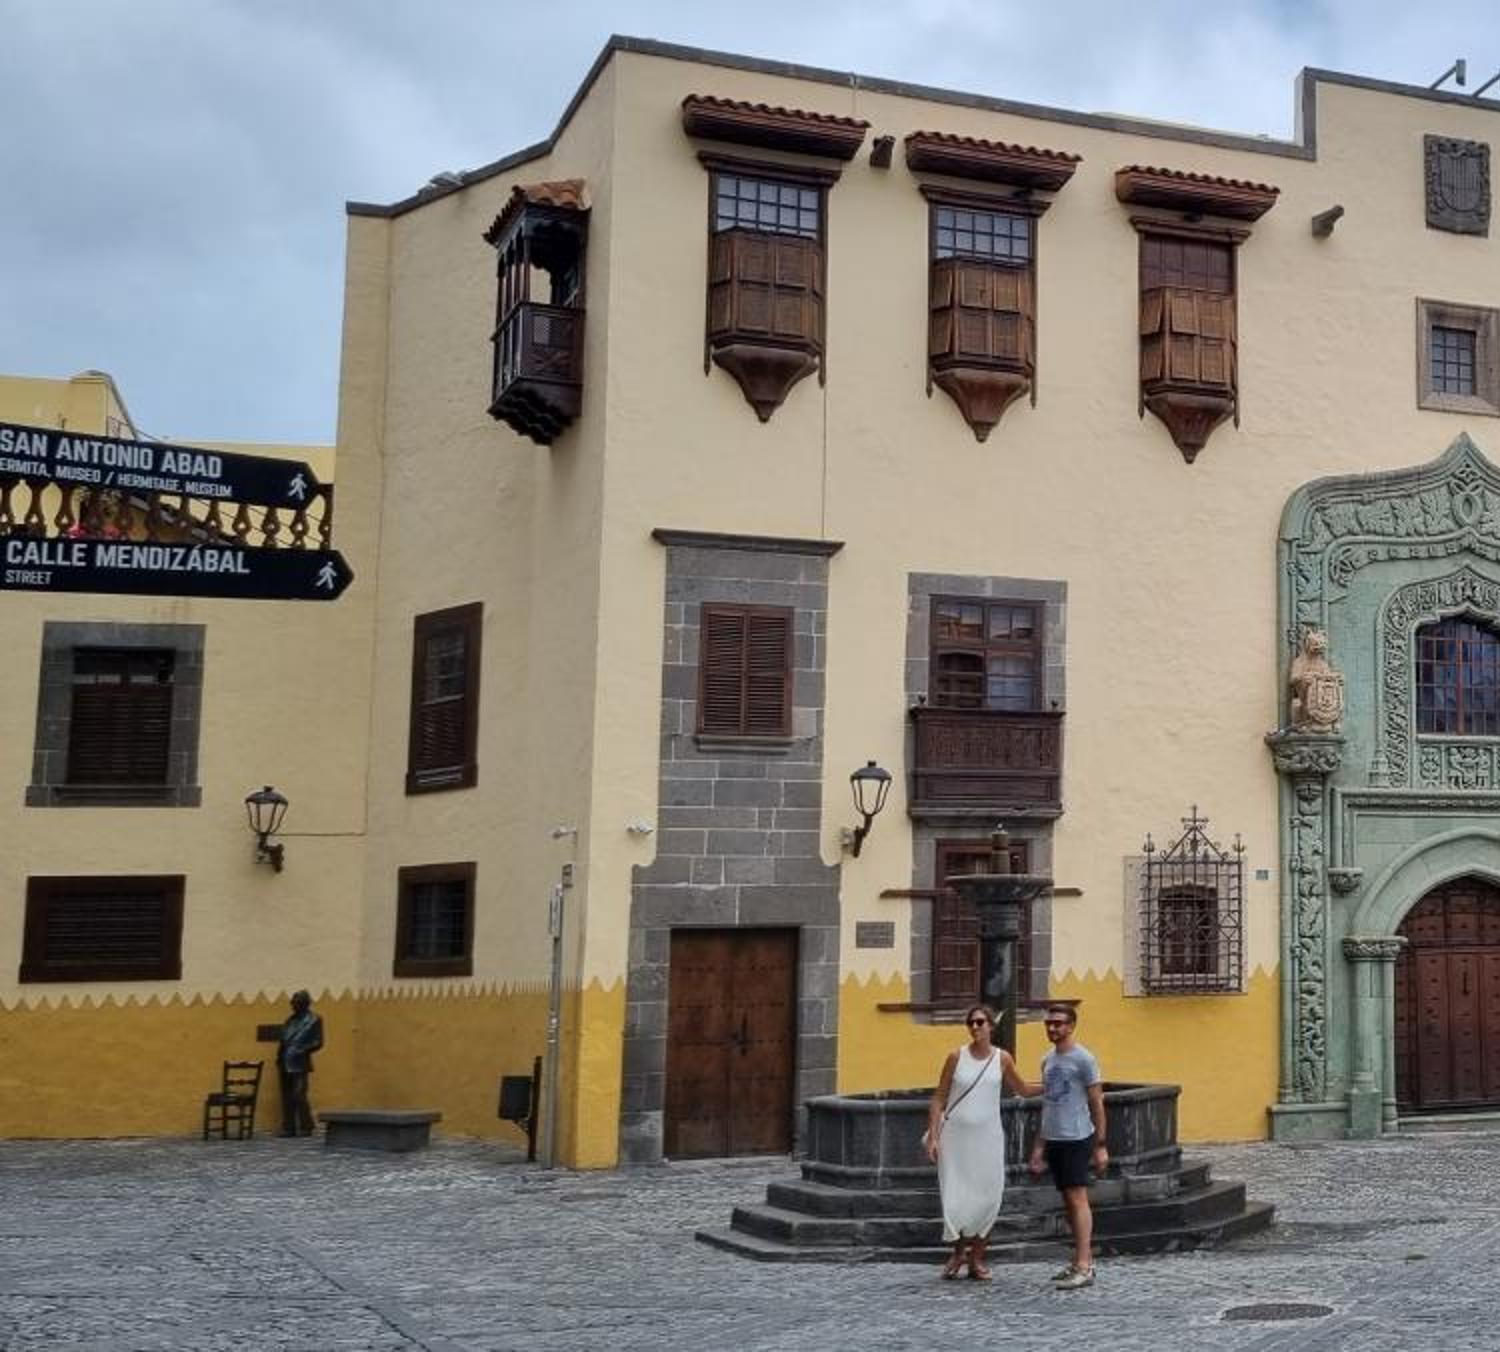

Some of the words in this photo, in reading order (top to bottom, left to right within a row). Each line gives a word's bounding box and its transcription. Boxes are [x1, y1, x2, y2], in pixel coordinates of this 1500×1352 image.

[0, 429, 48, 457] SAN
[56, 438, 153, 470] ANTONIO
[161, 451, 222, 478] ABAD
[56, 465, 101, 483] MUSEO
[104, 471, 115, 485] /
[185, 481, 232, 497] MUSEUM
[8, 541, 88, 566] CALLE
[96, 543, 250, 574] MENDIZÁBAL
[5, 569, 53, 585] STREET
